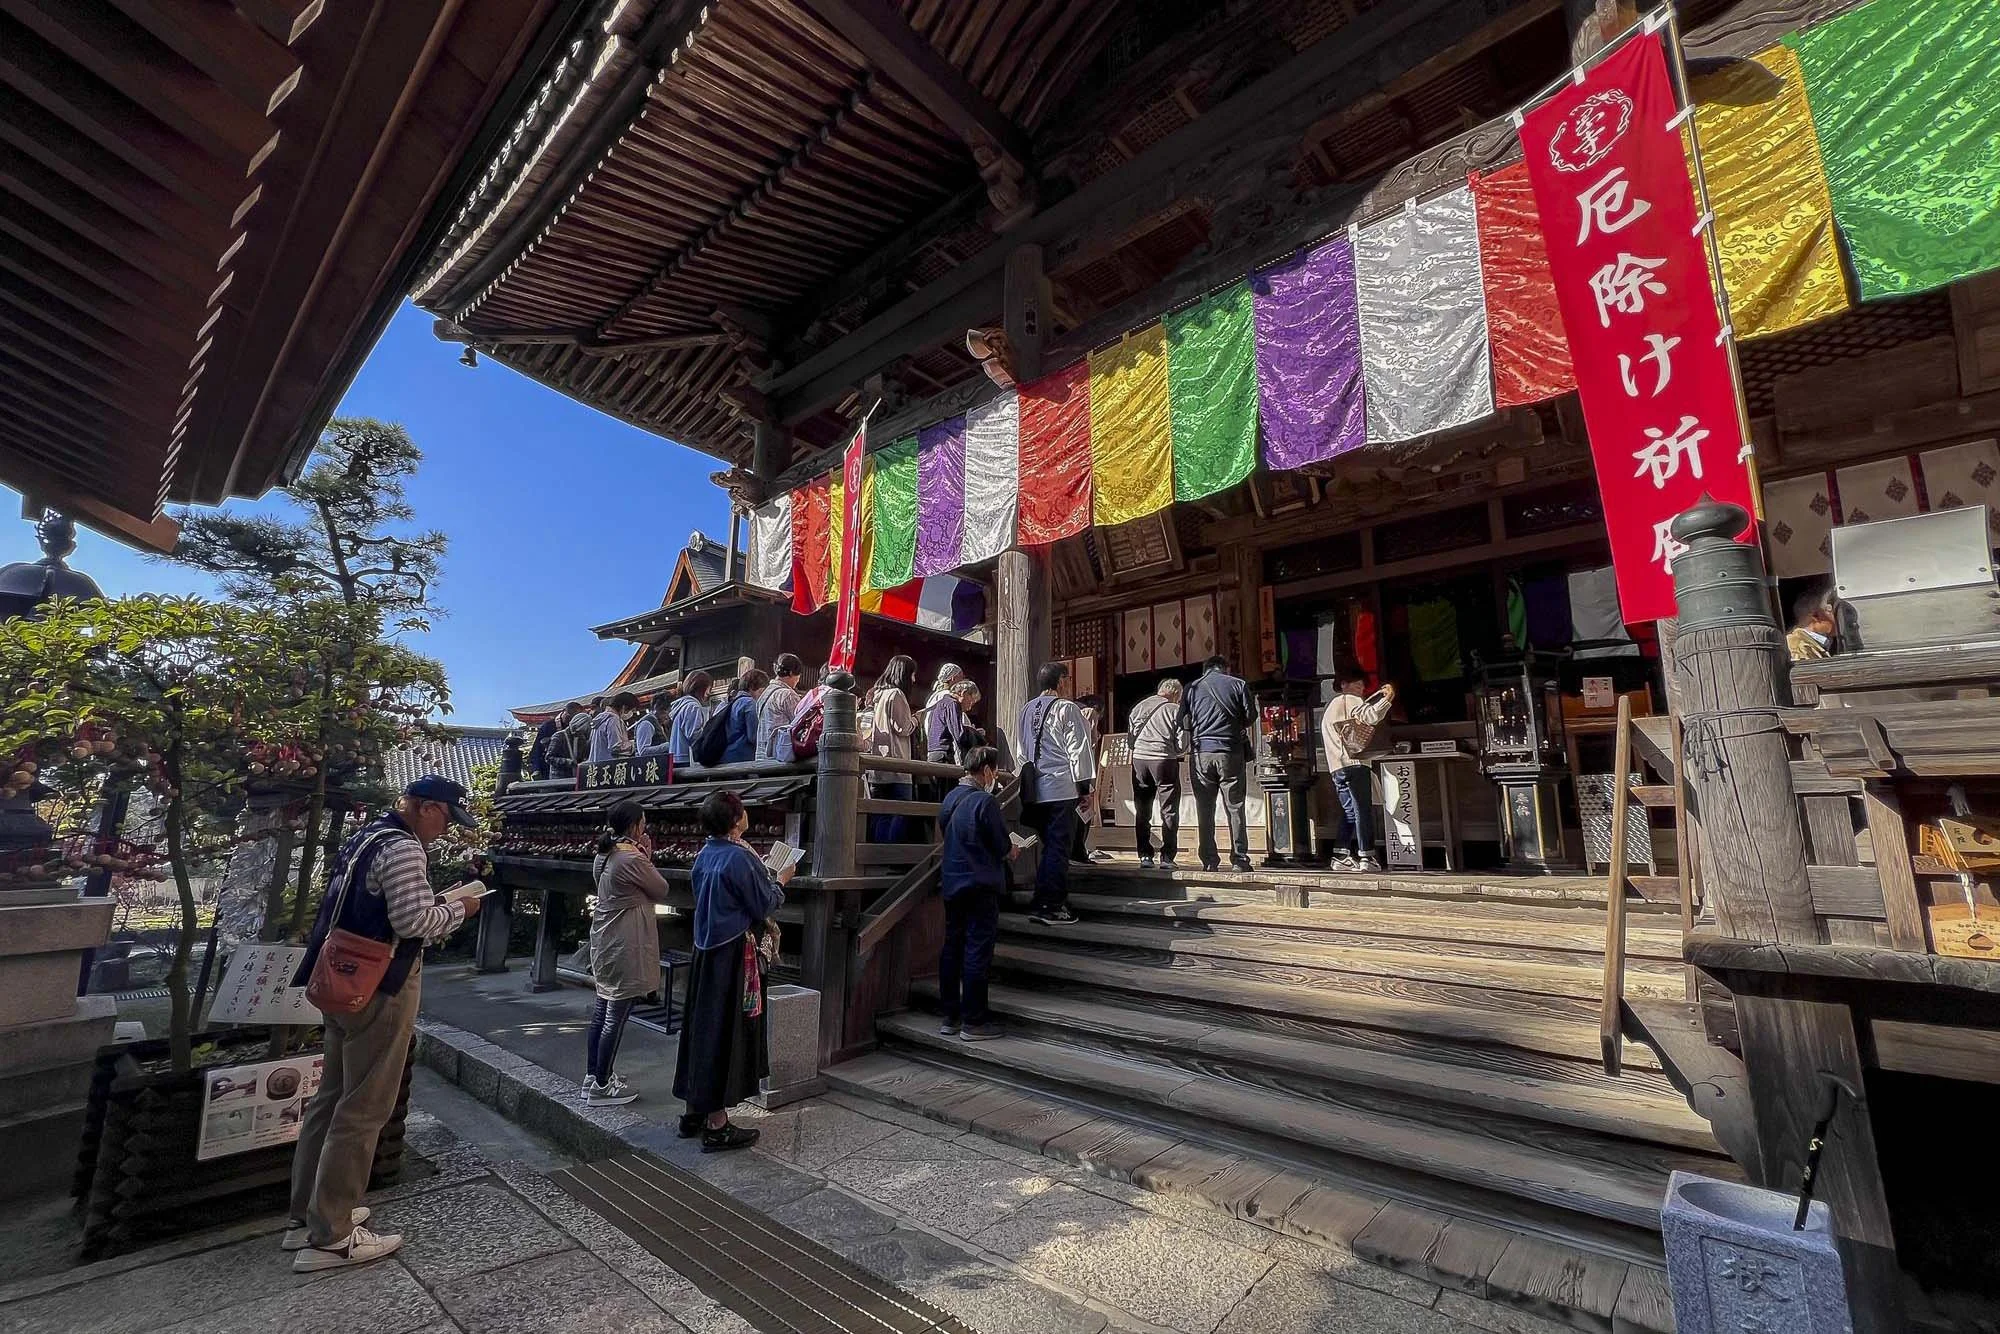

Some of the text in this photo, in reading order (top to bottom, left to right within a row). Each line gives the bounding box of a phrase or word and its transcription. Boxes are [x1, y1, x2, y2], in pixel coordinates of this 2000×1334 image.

[586, 757, 660, 788] 龍玉願い珠
[1389, 831, 1400, 861] 五十円
[293, 990, 304, 1009] える
